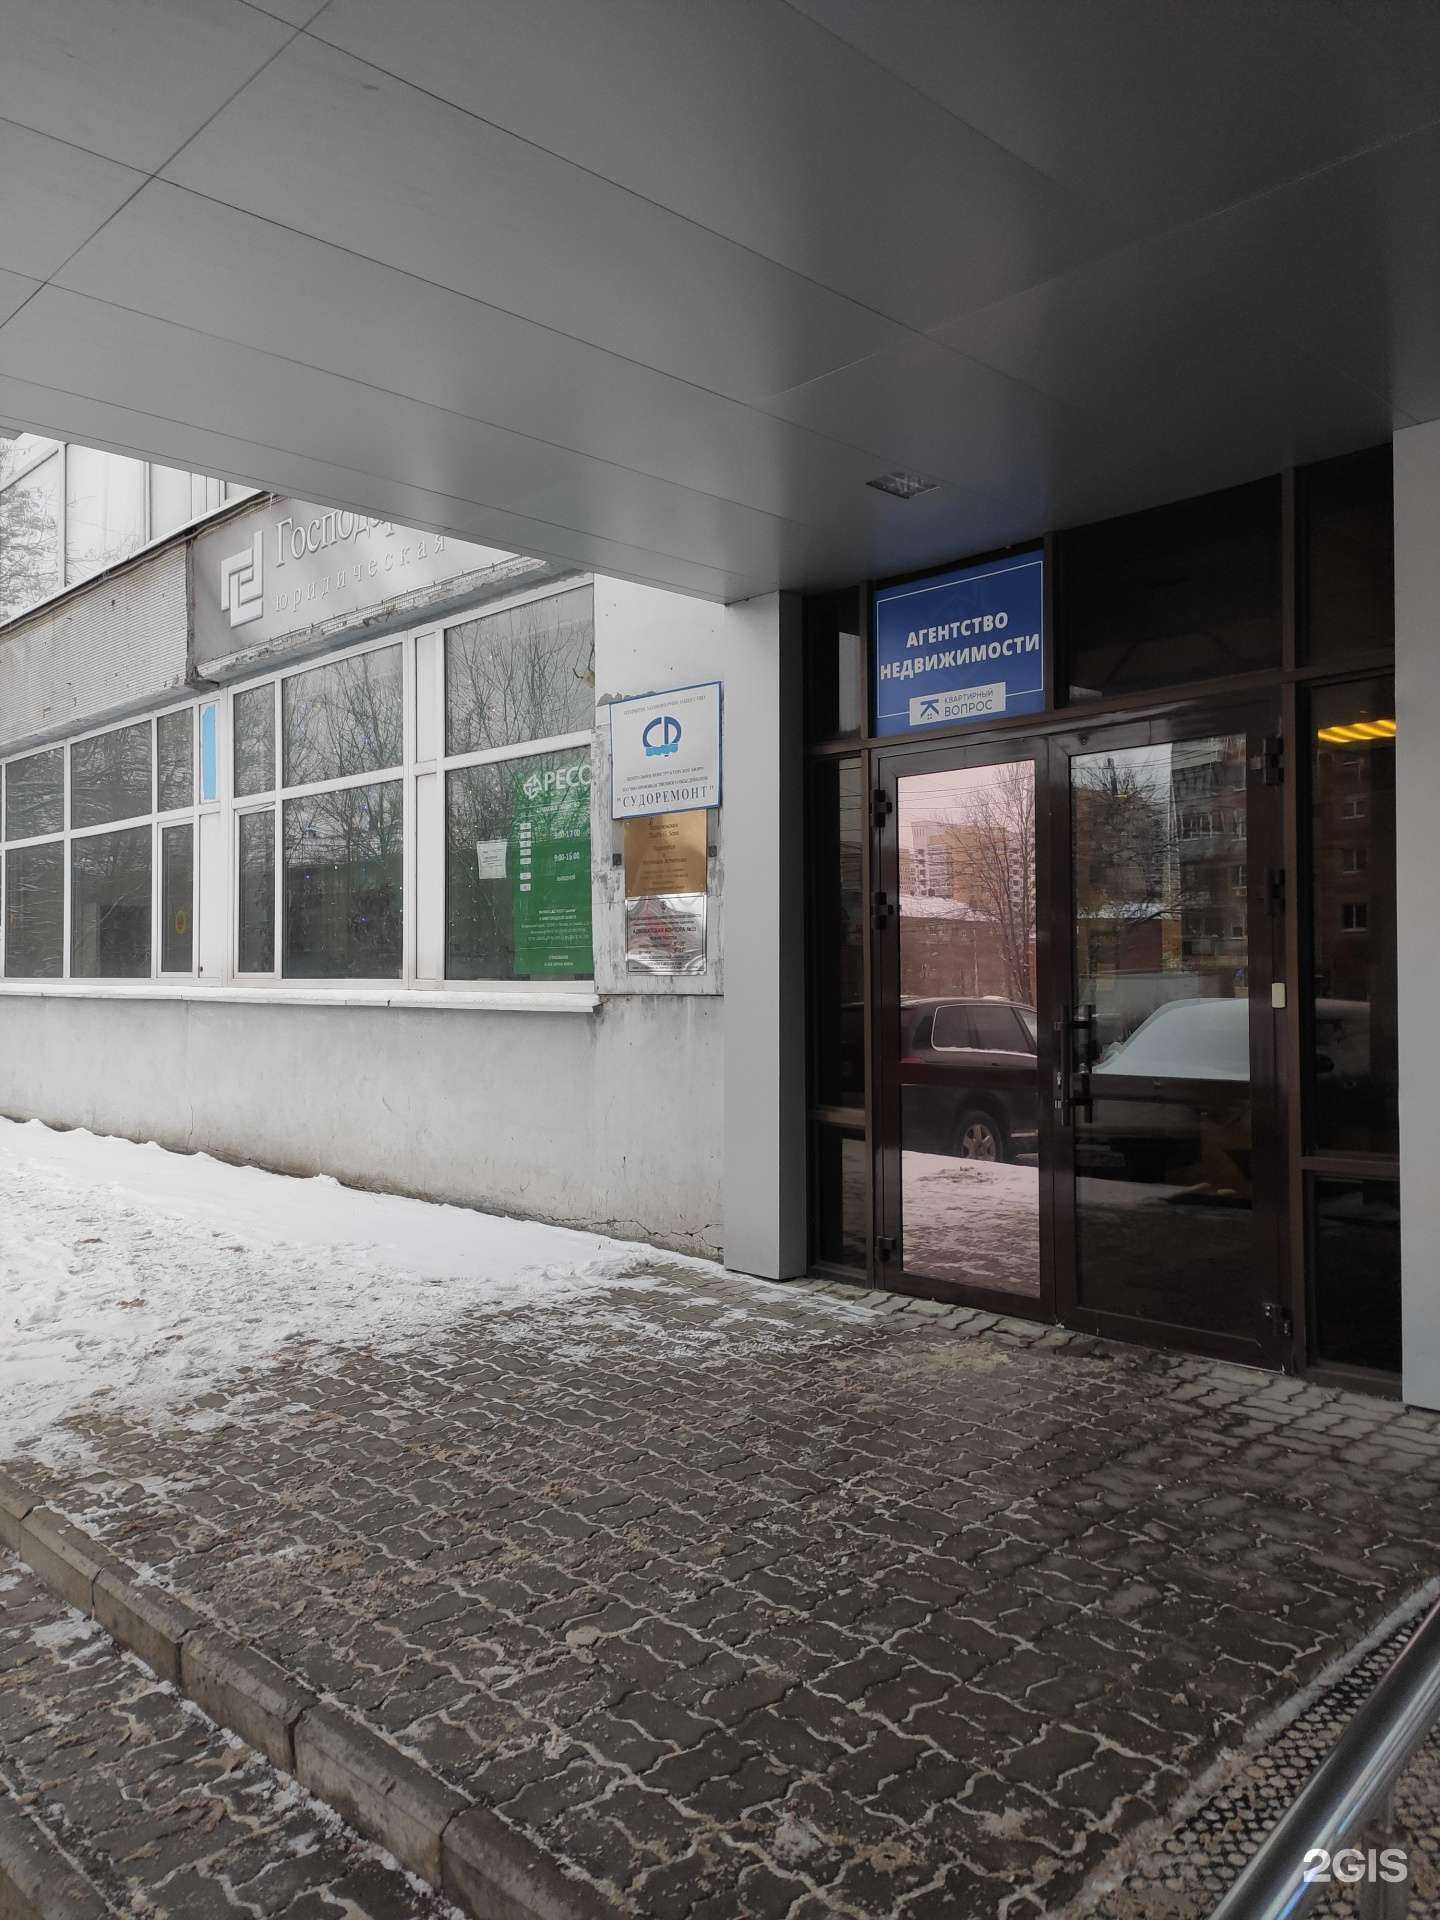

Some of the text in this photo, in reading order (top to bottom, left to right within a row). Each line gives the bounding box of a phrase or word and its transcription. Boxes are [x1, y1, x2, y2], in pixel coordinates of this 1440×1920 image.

[273, 535, 448, 613] юридическая
[906, 612, 1008, 649] АГЕНТСТВО
[880, 633, 1040, 680] НЕДВИЖИМОСТИ
[944, 688, 993, 703] КВАРТИРНЫЙ
[944, 698, 993, 718] ВОПРОС
